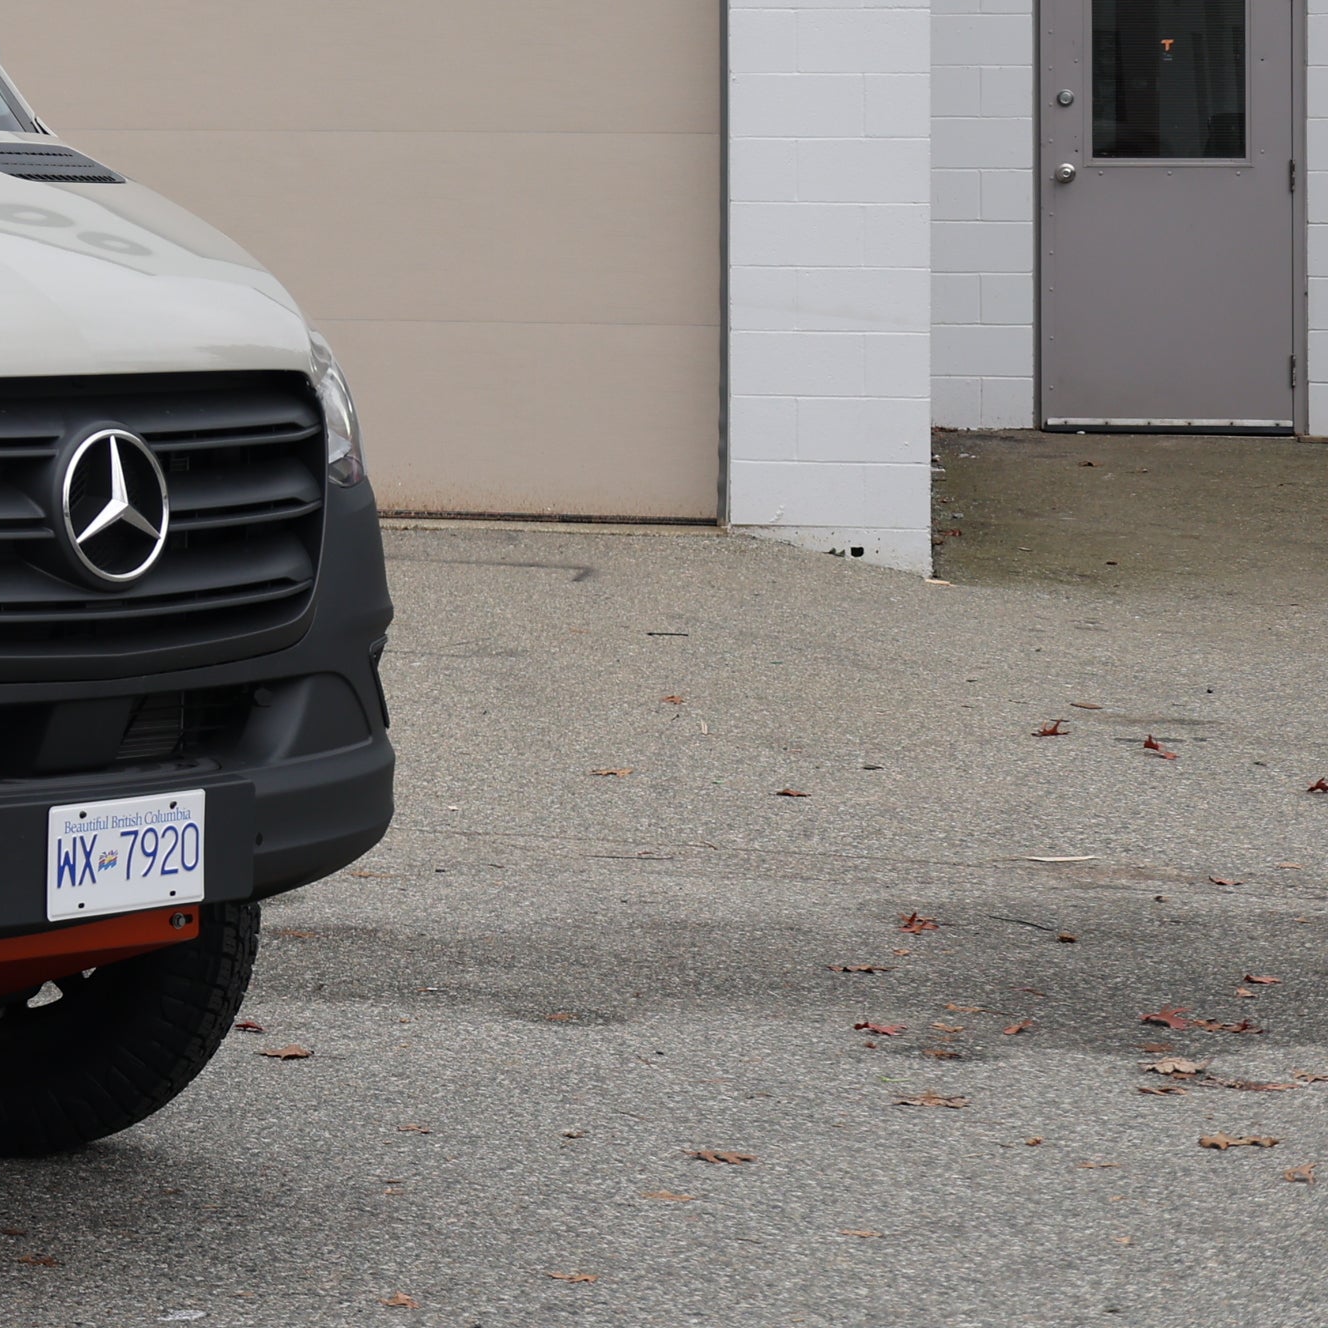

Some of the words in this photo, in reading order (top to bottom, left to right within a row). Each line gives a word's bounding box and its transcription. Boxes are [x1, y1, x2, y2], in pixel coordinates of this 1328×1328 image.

[64, 816, 109, 834] Beautiful
[111, 811, 142, 829] British
[144, 807, 191, 825] Columbia
[57, 834, 97, 889] WX
[120, 822, 199, 881] 7920
